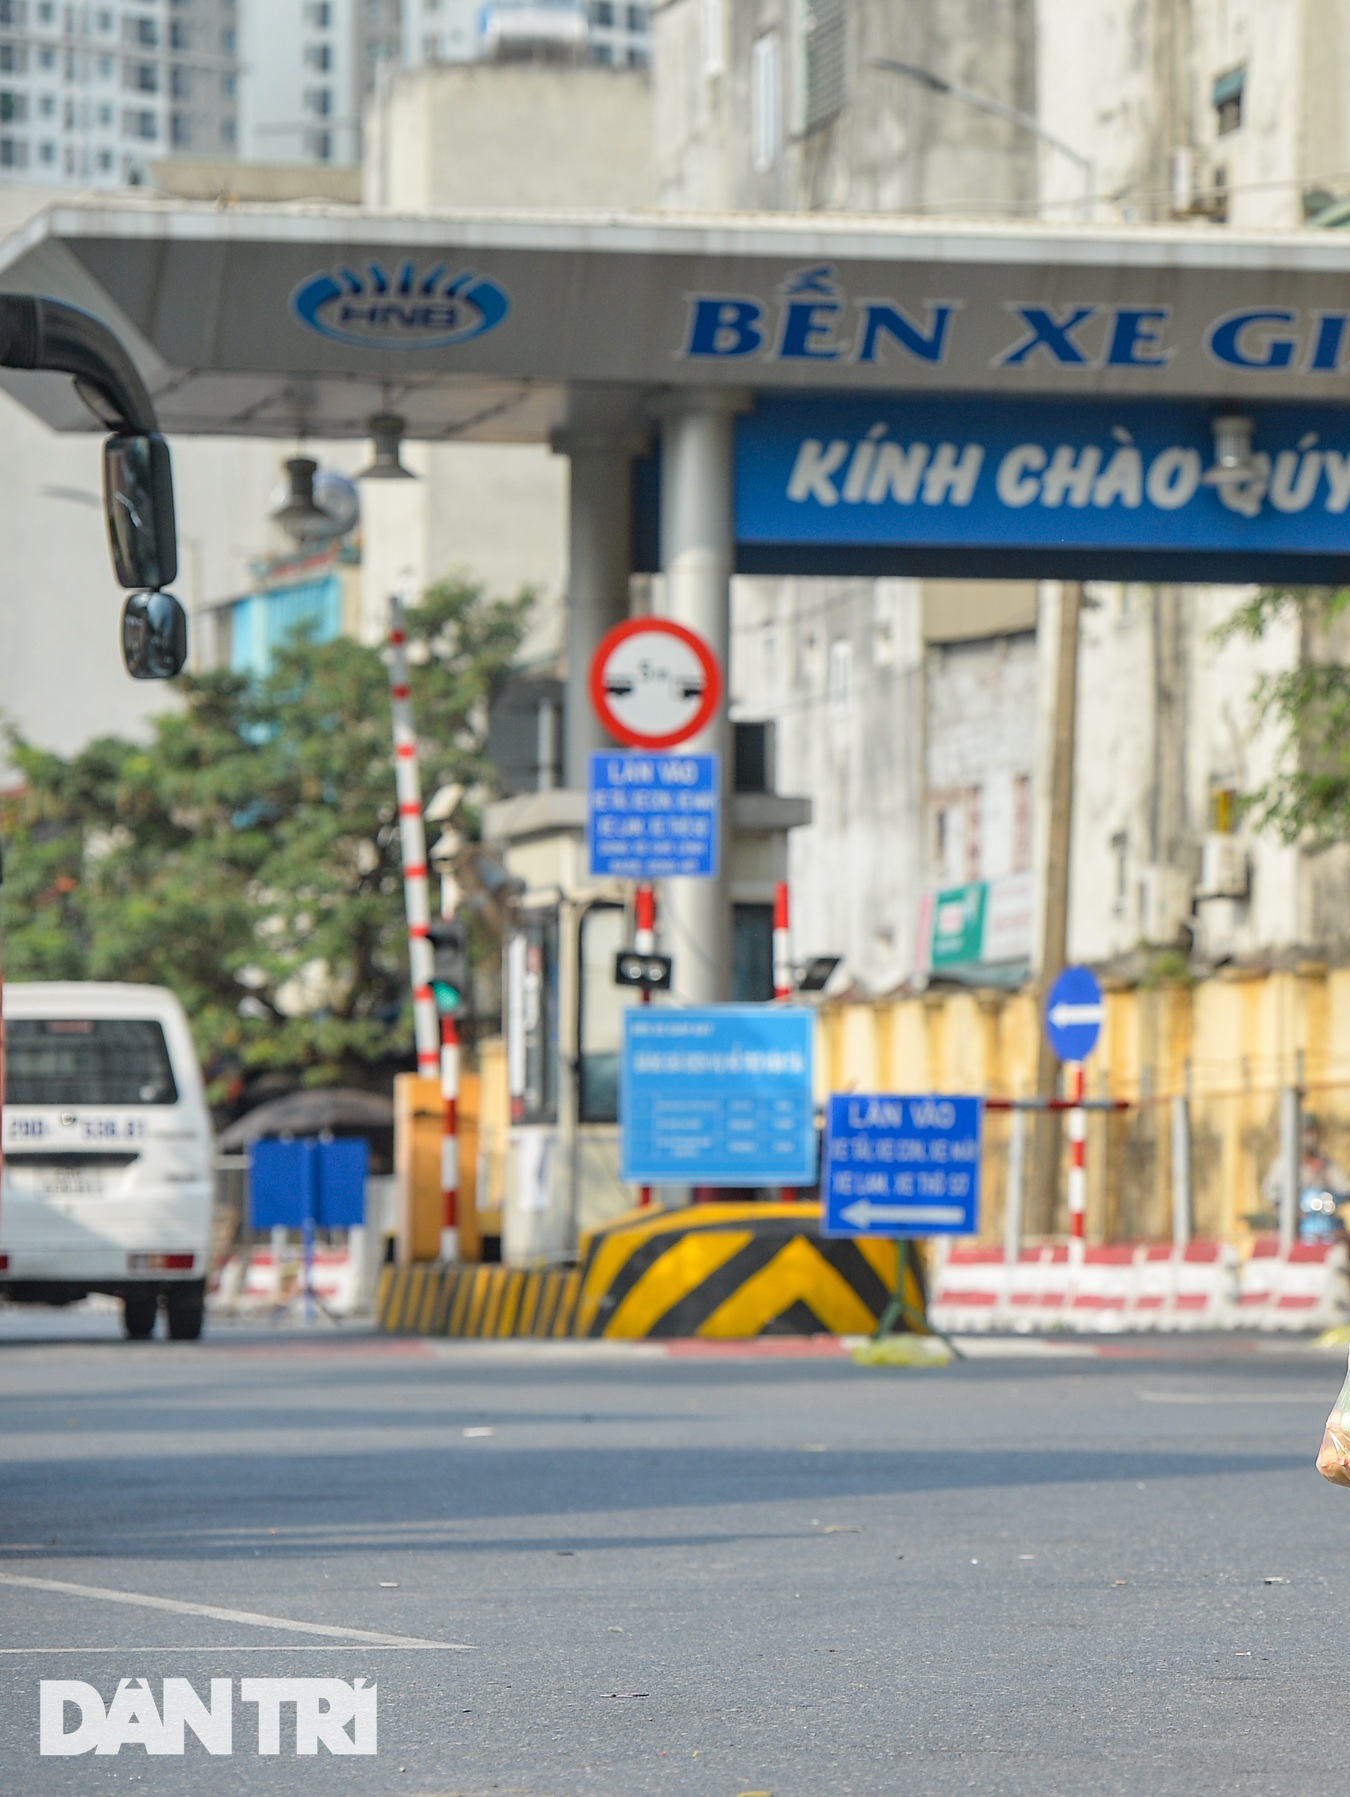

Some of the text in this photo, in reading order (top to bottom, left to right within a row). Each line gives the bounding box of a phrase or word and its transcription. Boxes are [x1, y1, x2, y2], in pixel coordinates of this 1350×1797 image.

[342, 304, 457, 327] HNB
[685, 265, 957, 364] BẾN
[995, 304, 1173, 367] XE
[787, 422, 985, 507] KÍNH
[996, 425, 1200, 509] CHÀO
